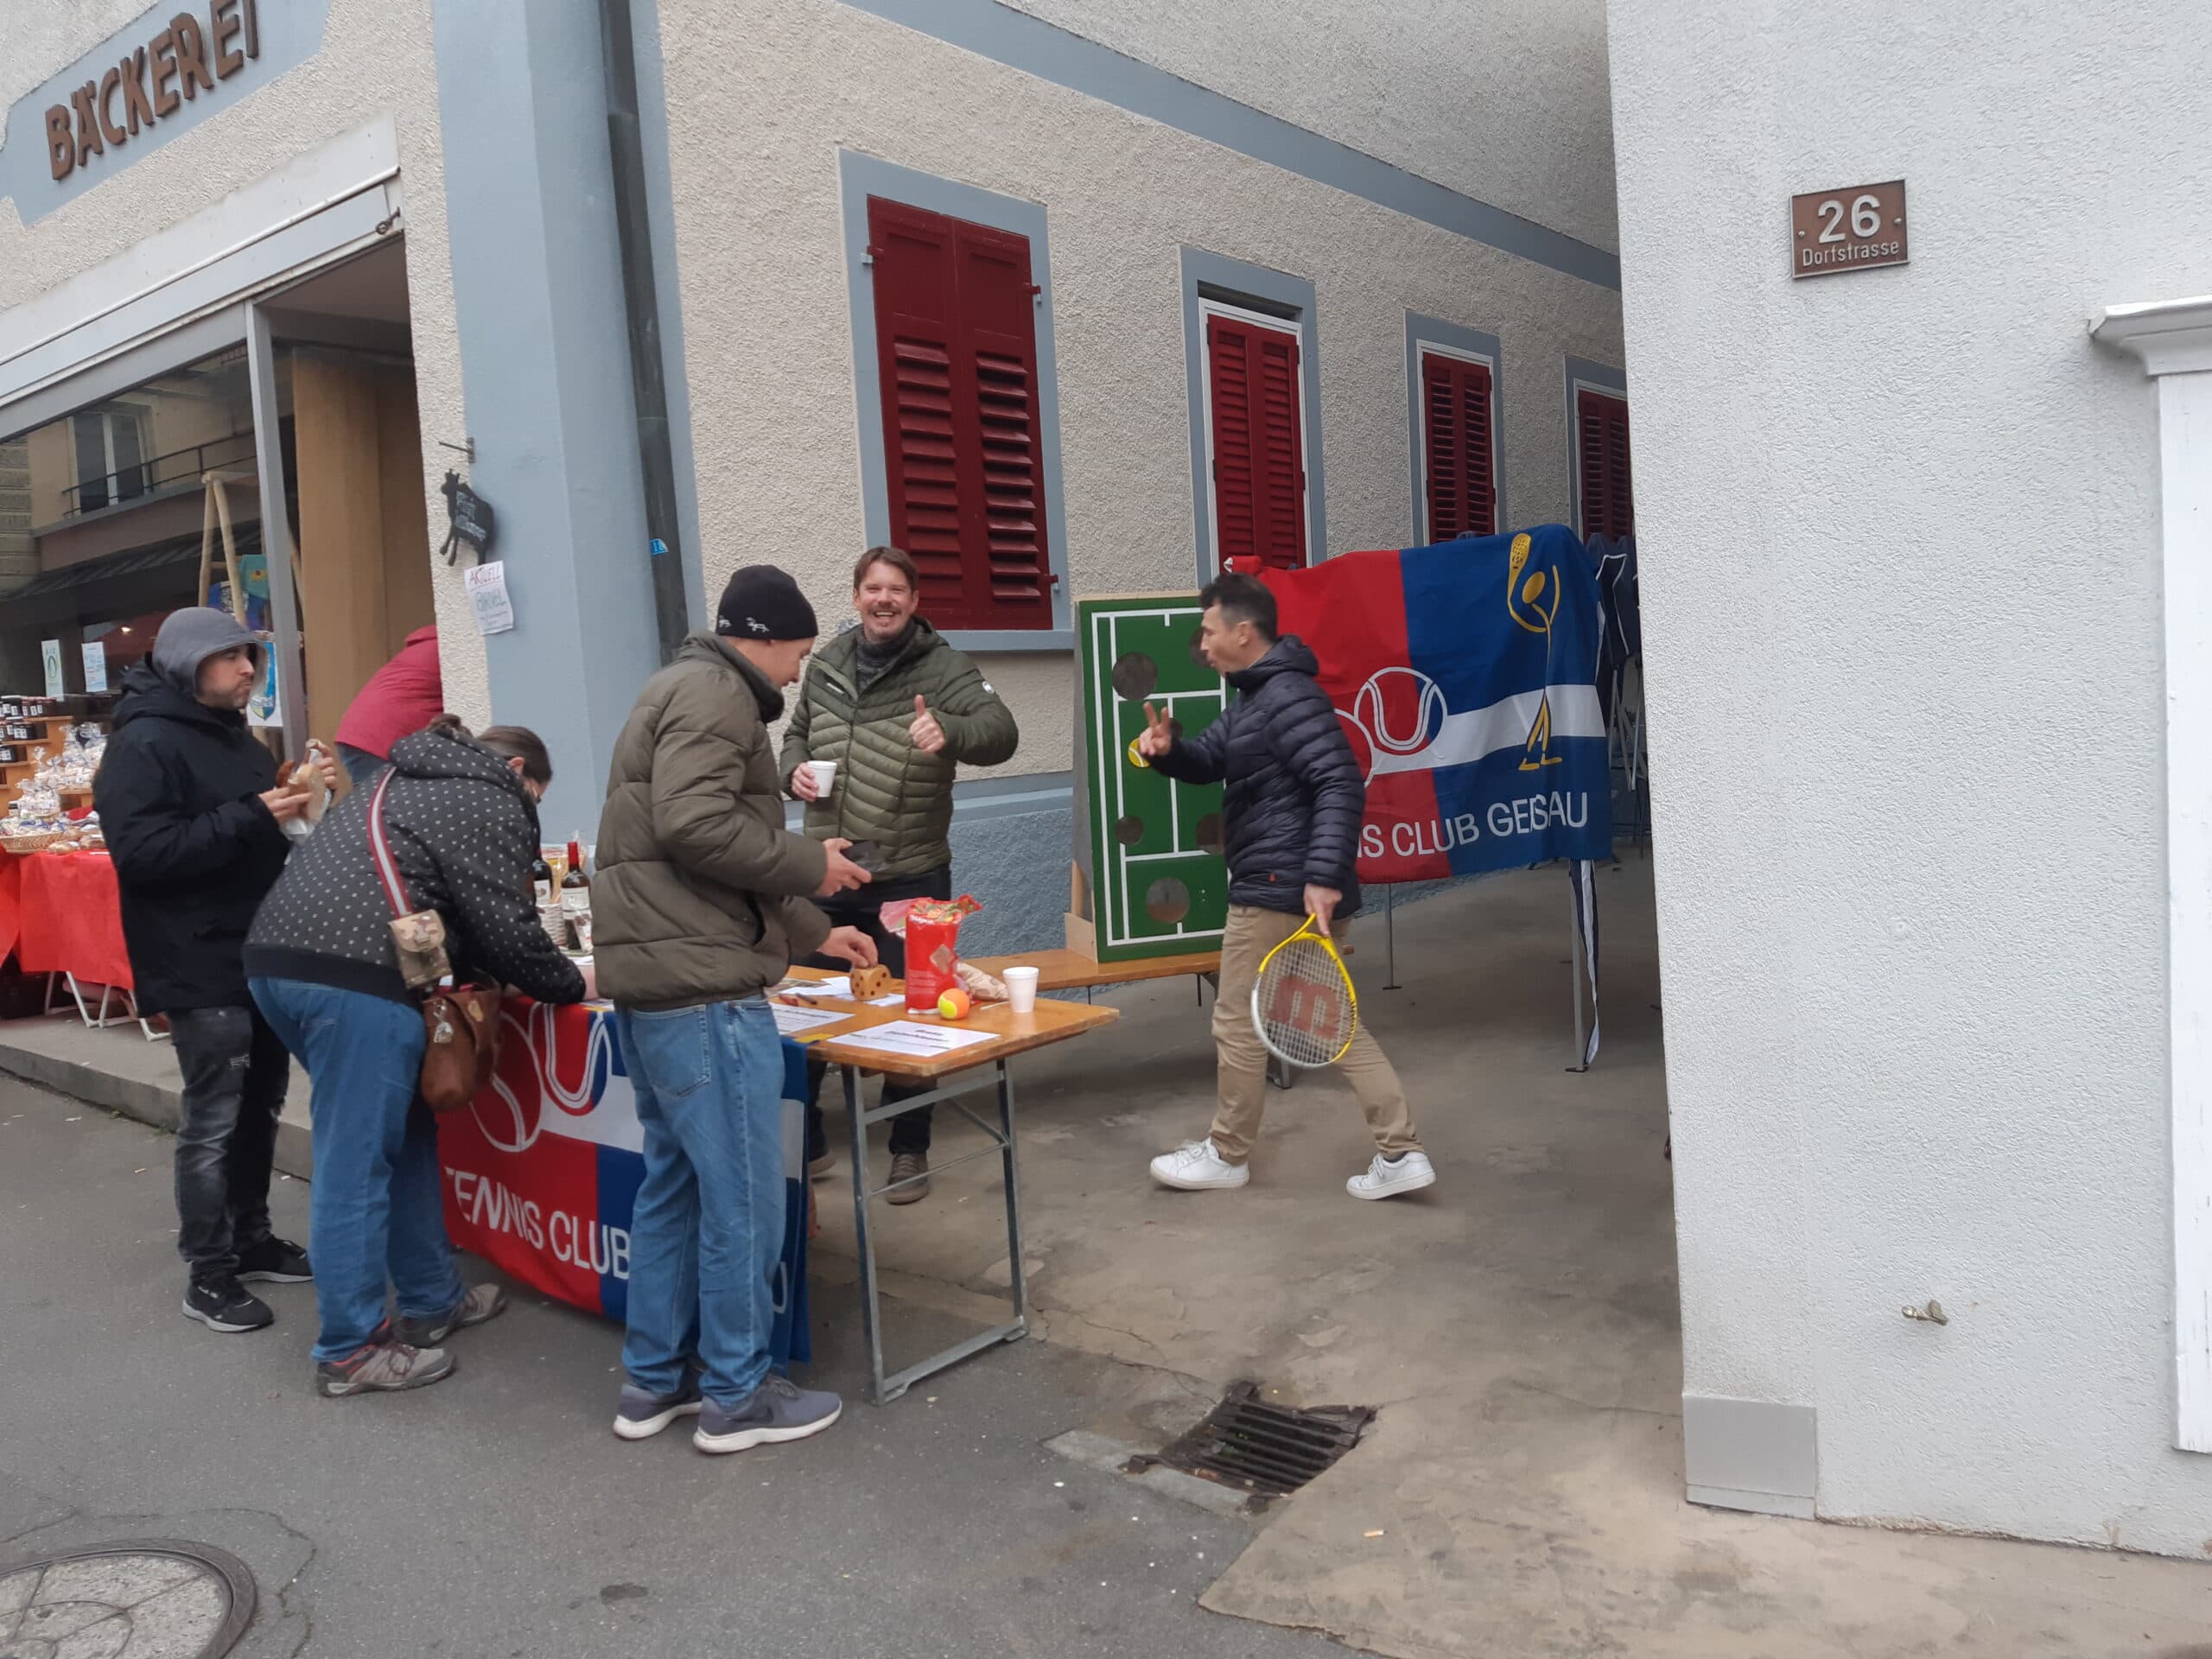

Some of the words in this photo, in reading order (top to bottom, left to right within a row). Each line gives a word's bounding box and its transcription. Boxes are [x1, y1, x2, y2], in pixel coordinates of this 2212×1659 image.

[45, 0, 259, 181] BÄCKEREI
[1817, 194, 1881, 244] 26
[1802, 239, 1899, 268] Dorfstrasse
[1391, 812, 1480, 857] CLUB
[550, 1210, 631, 1281] CLUB
